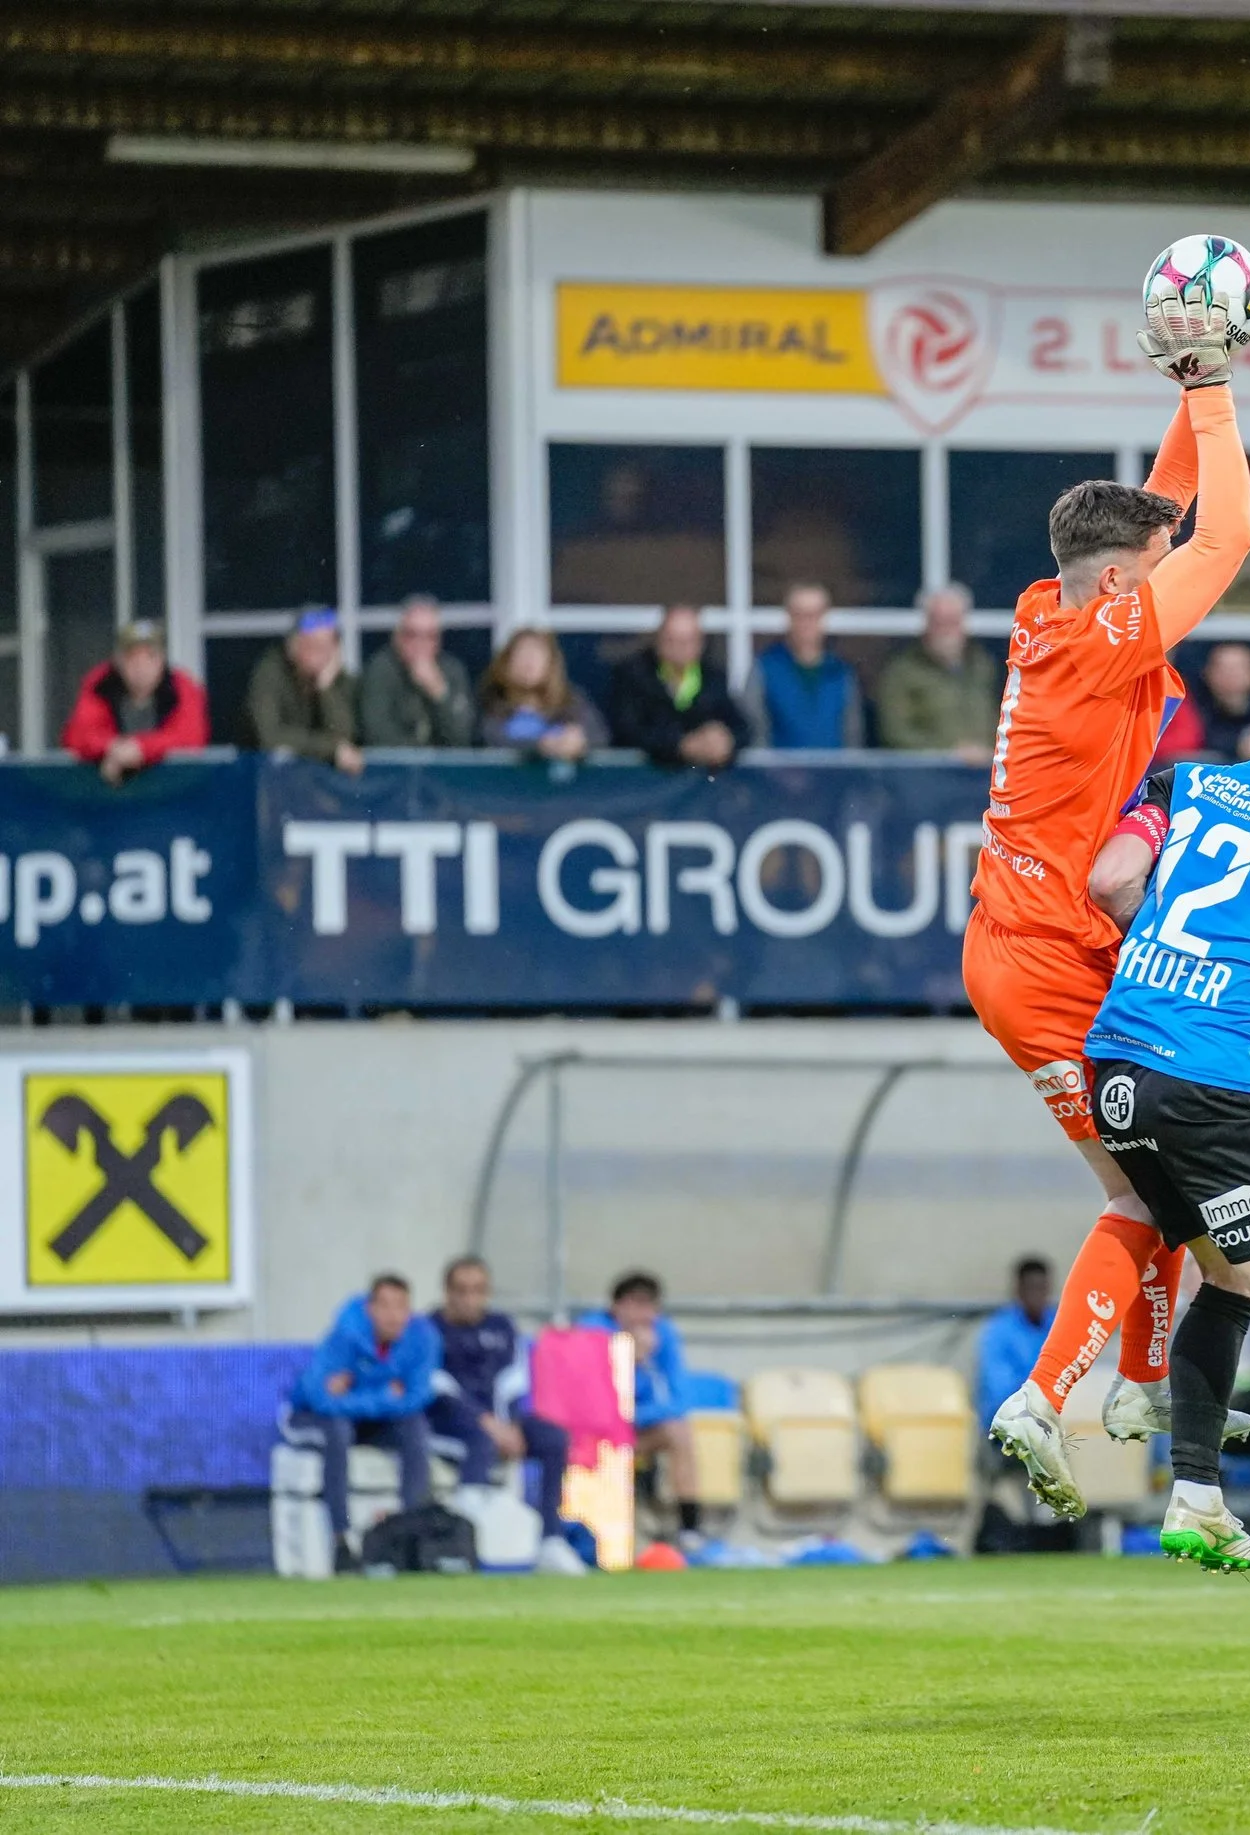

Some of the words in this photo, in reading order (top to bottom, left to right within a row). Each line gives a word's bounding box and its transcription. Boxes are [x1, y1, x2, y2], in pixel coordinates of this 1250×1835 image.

[580, 312, 847, 363] ADMIRAL
[284, 822, 499, 934] TTI
[1142, 1285, 1169, 1367] easystaff
